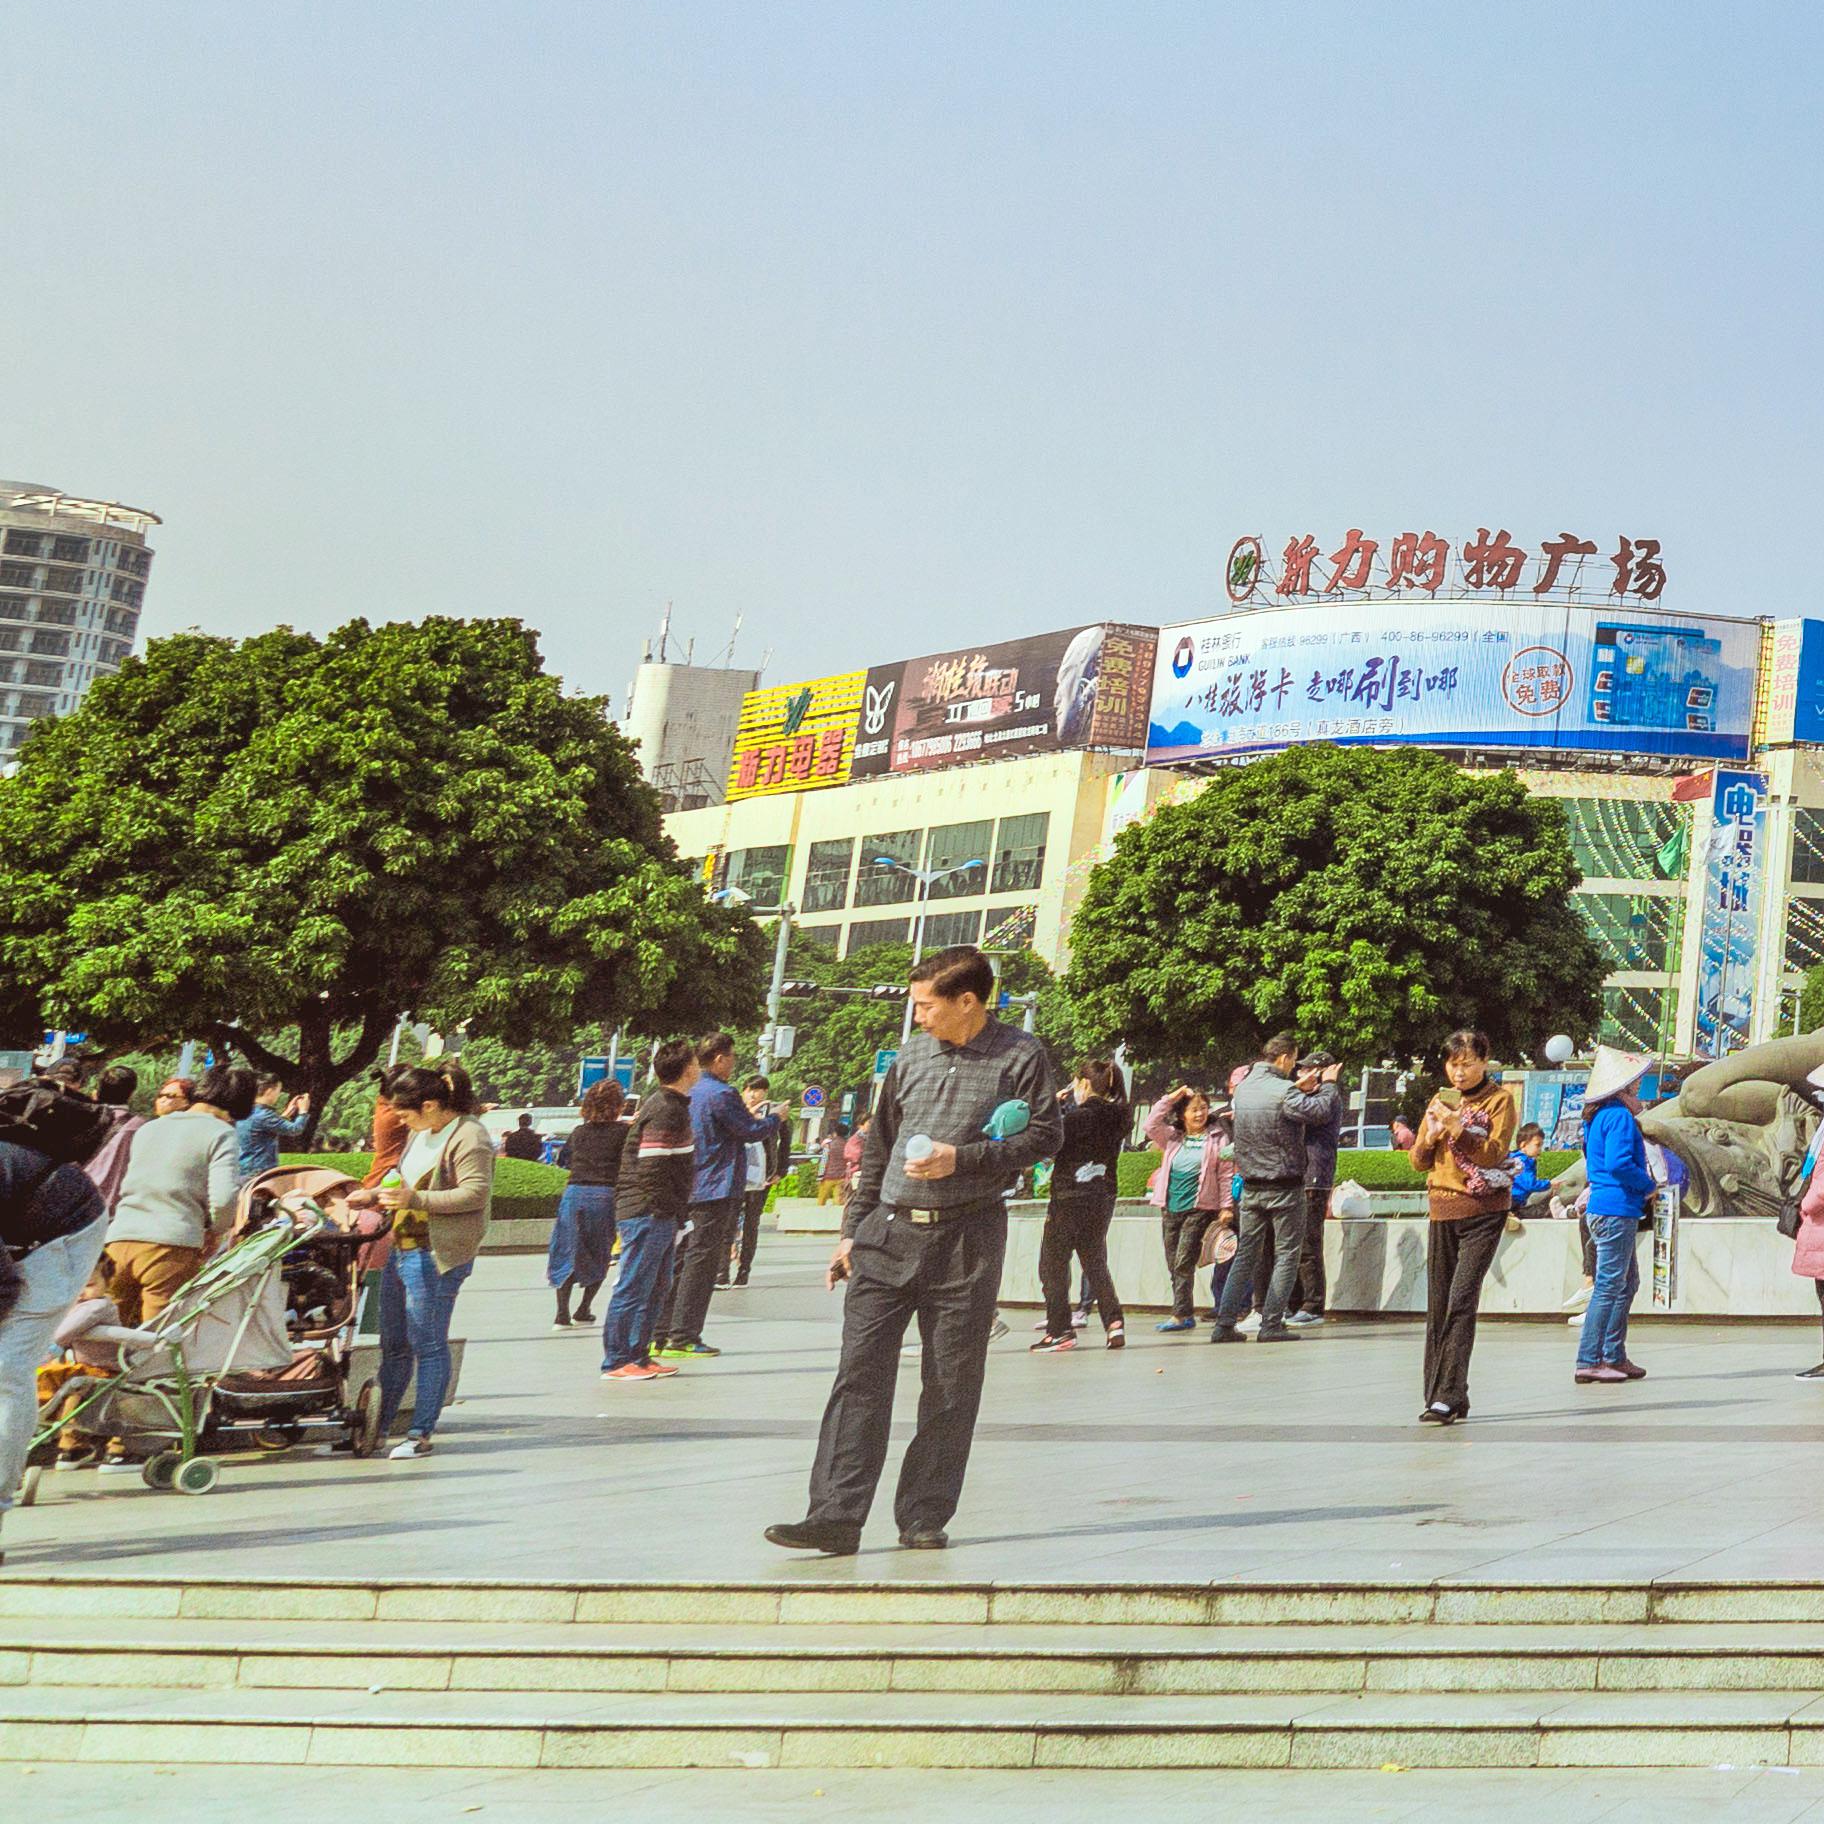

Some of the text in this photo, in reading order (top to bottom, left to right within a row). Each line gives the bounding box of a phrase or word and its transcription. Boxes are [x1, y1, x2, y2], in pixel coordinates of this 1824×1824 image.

[1276, 528, 1668, 601] 新力购物广场
[1095, 637, 1137, 717] 免费培训
[1515, 678, 1562, 706] 免费
[1772, 634, 1798, 711] 免费培训
[736, 728, 845, 789] 新力电器
